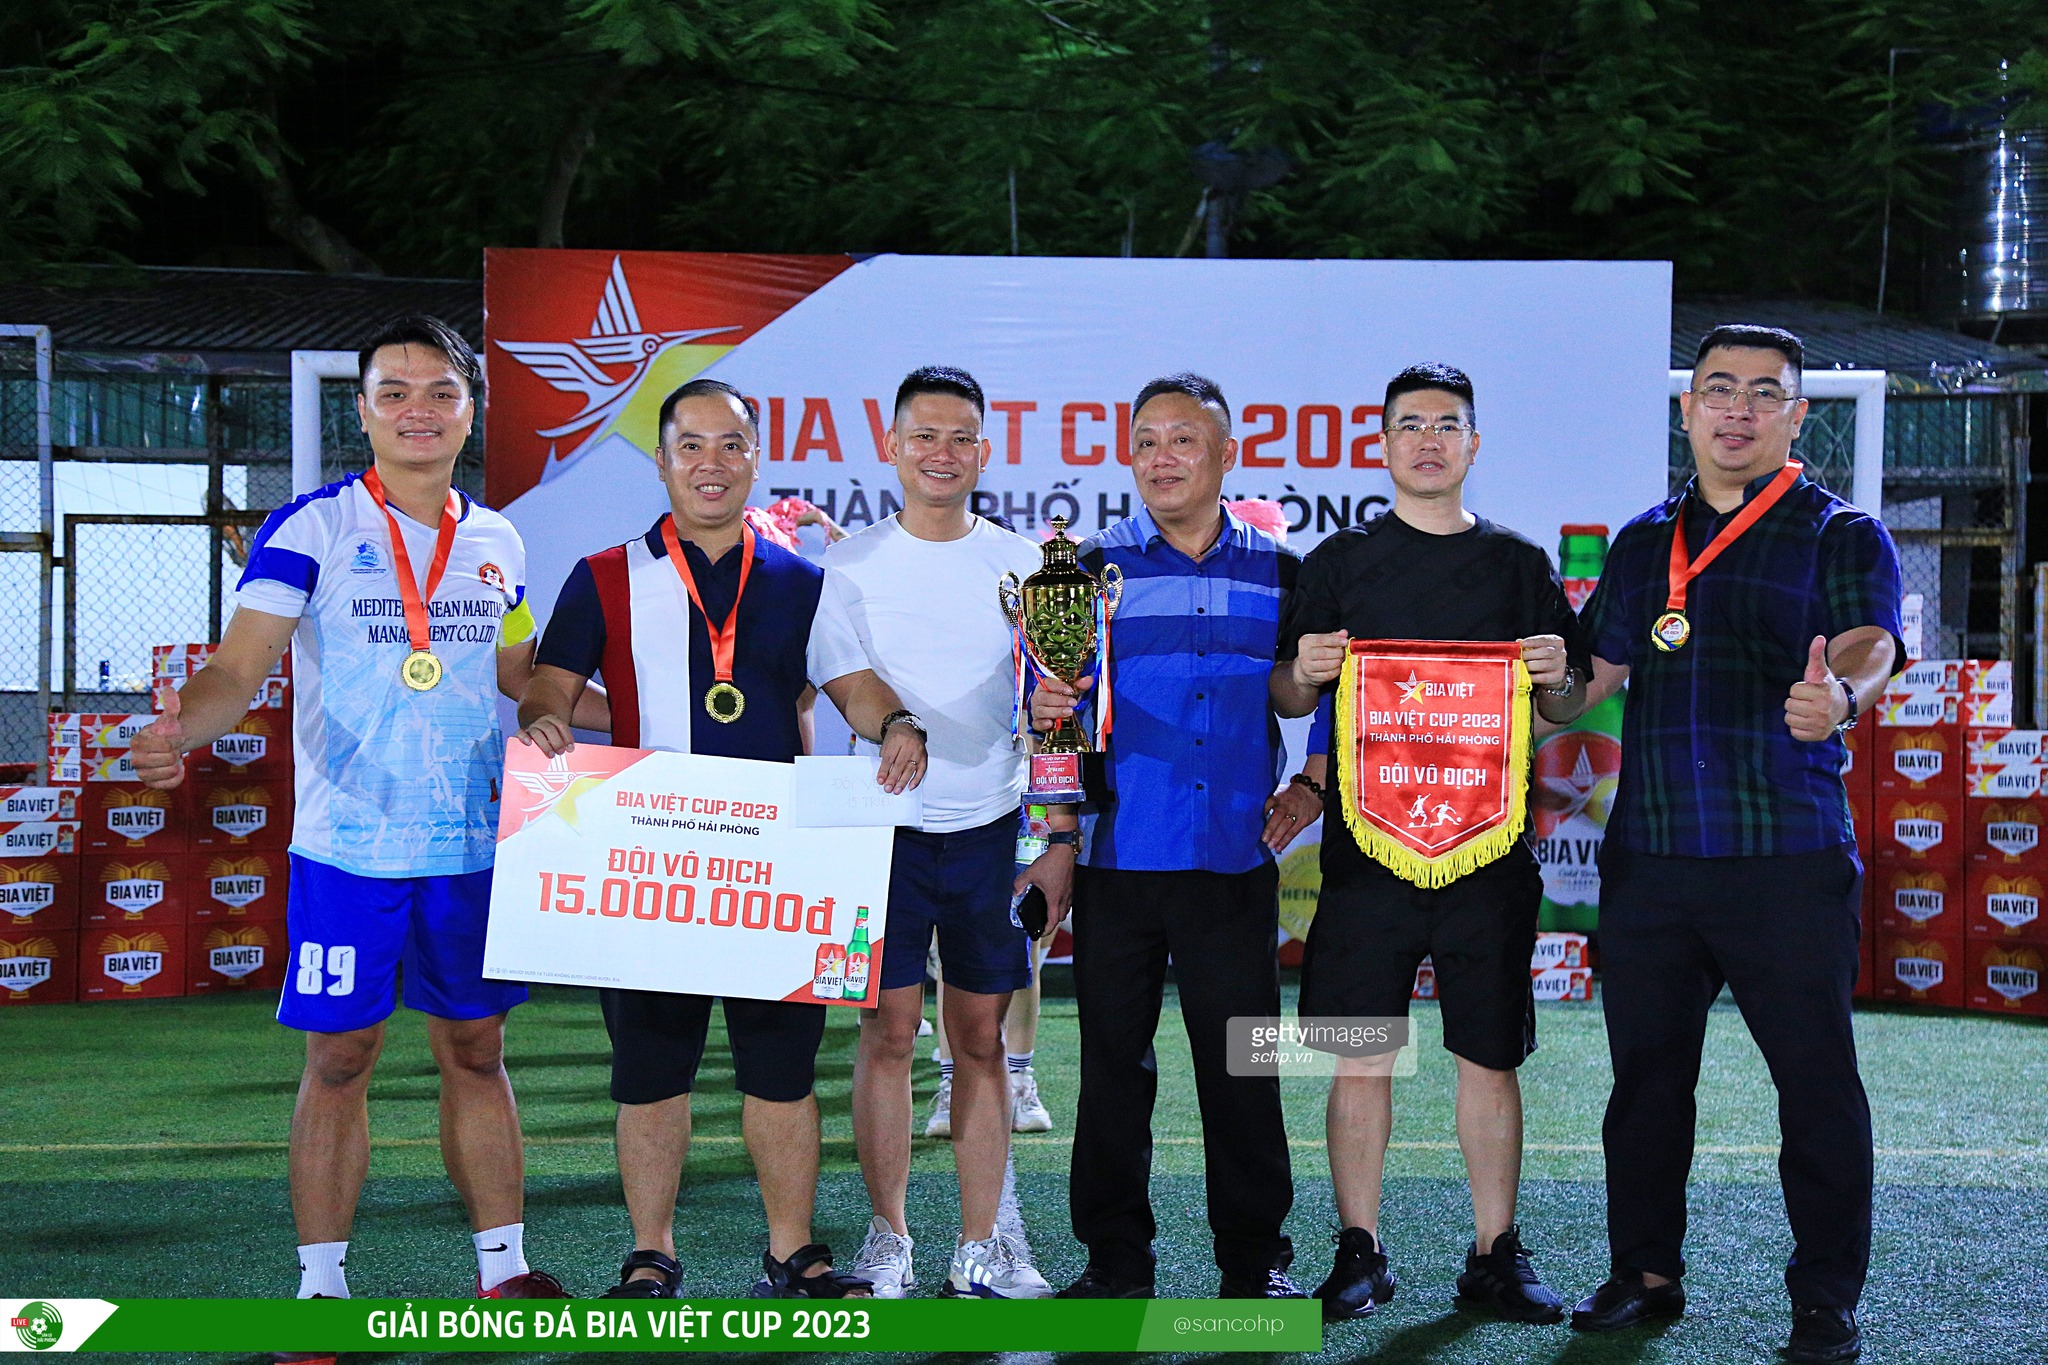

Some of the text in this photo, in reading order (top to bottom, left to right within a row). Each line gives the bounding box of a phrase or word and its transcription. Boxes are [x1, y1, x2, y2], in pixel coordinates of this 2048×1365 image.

[742, 396, 844, 462] IA
[1242, 404, 1388, 469] 202
[971, 478, 1081, 530] PHỐ
[1369, 709, 1501, 729] BIA VIỆT CUP 2023
[1370, 730, 1500, 745] THÀNH PHỐ HẢI PHÒNG
[120, 759, 134, 771] BI
[1379, 763, 1486, 790] ĐỘI VÔ ĐỊCH
[616, 791, 778, 821] BIA VIỆT CUP 2023
[112, 810, 162, 828] BIA VIỆT
[631, 815, 760, 836] THÀNH PHỐ HẢI PHÒNG
[1538, 838, 1599, 865] BIA VI
[608, 846, 773, 888] ĐỘI VÔ ĐỊCH
[22, 886, 51, 905] VIỆT
[110, 883, 160, 902] BIA VIỆT
[1282, 888, 1319, 900] HEIN
[539, 872, 836, 936] 15.000.000đ
[108, 955, 158, 974] BIA VIỆT
[296, 941, 356, 997] 89
